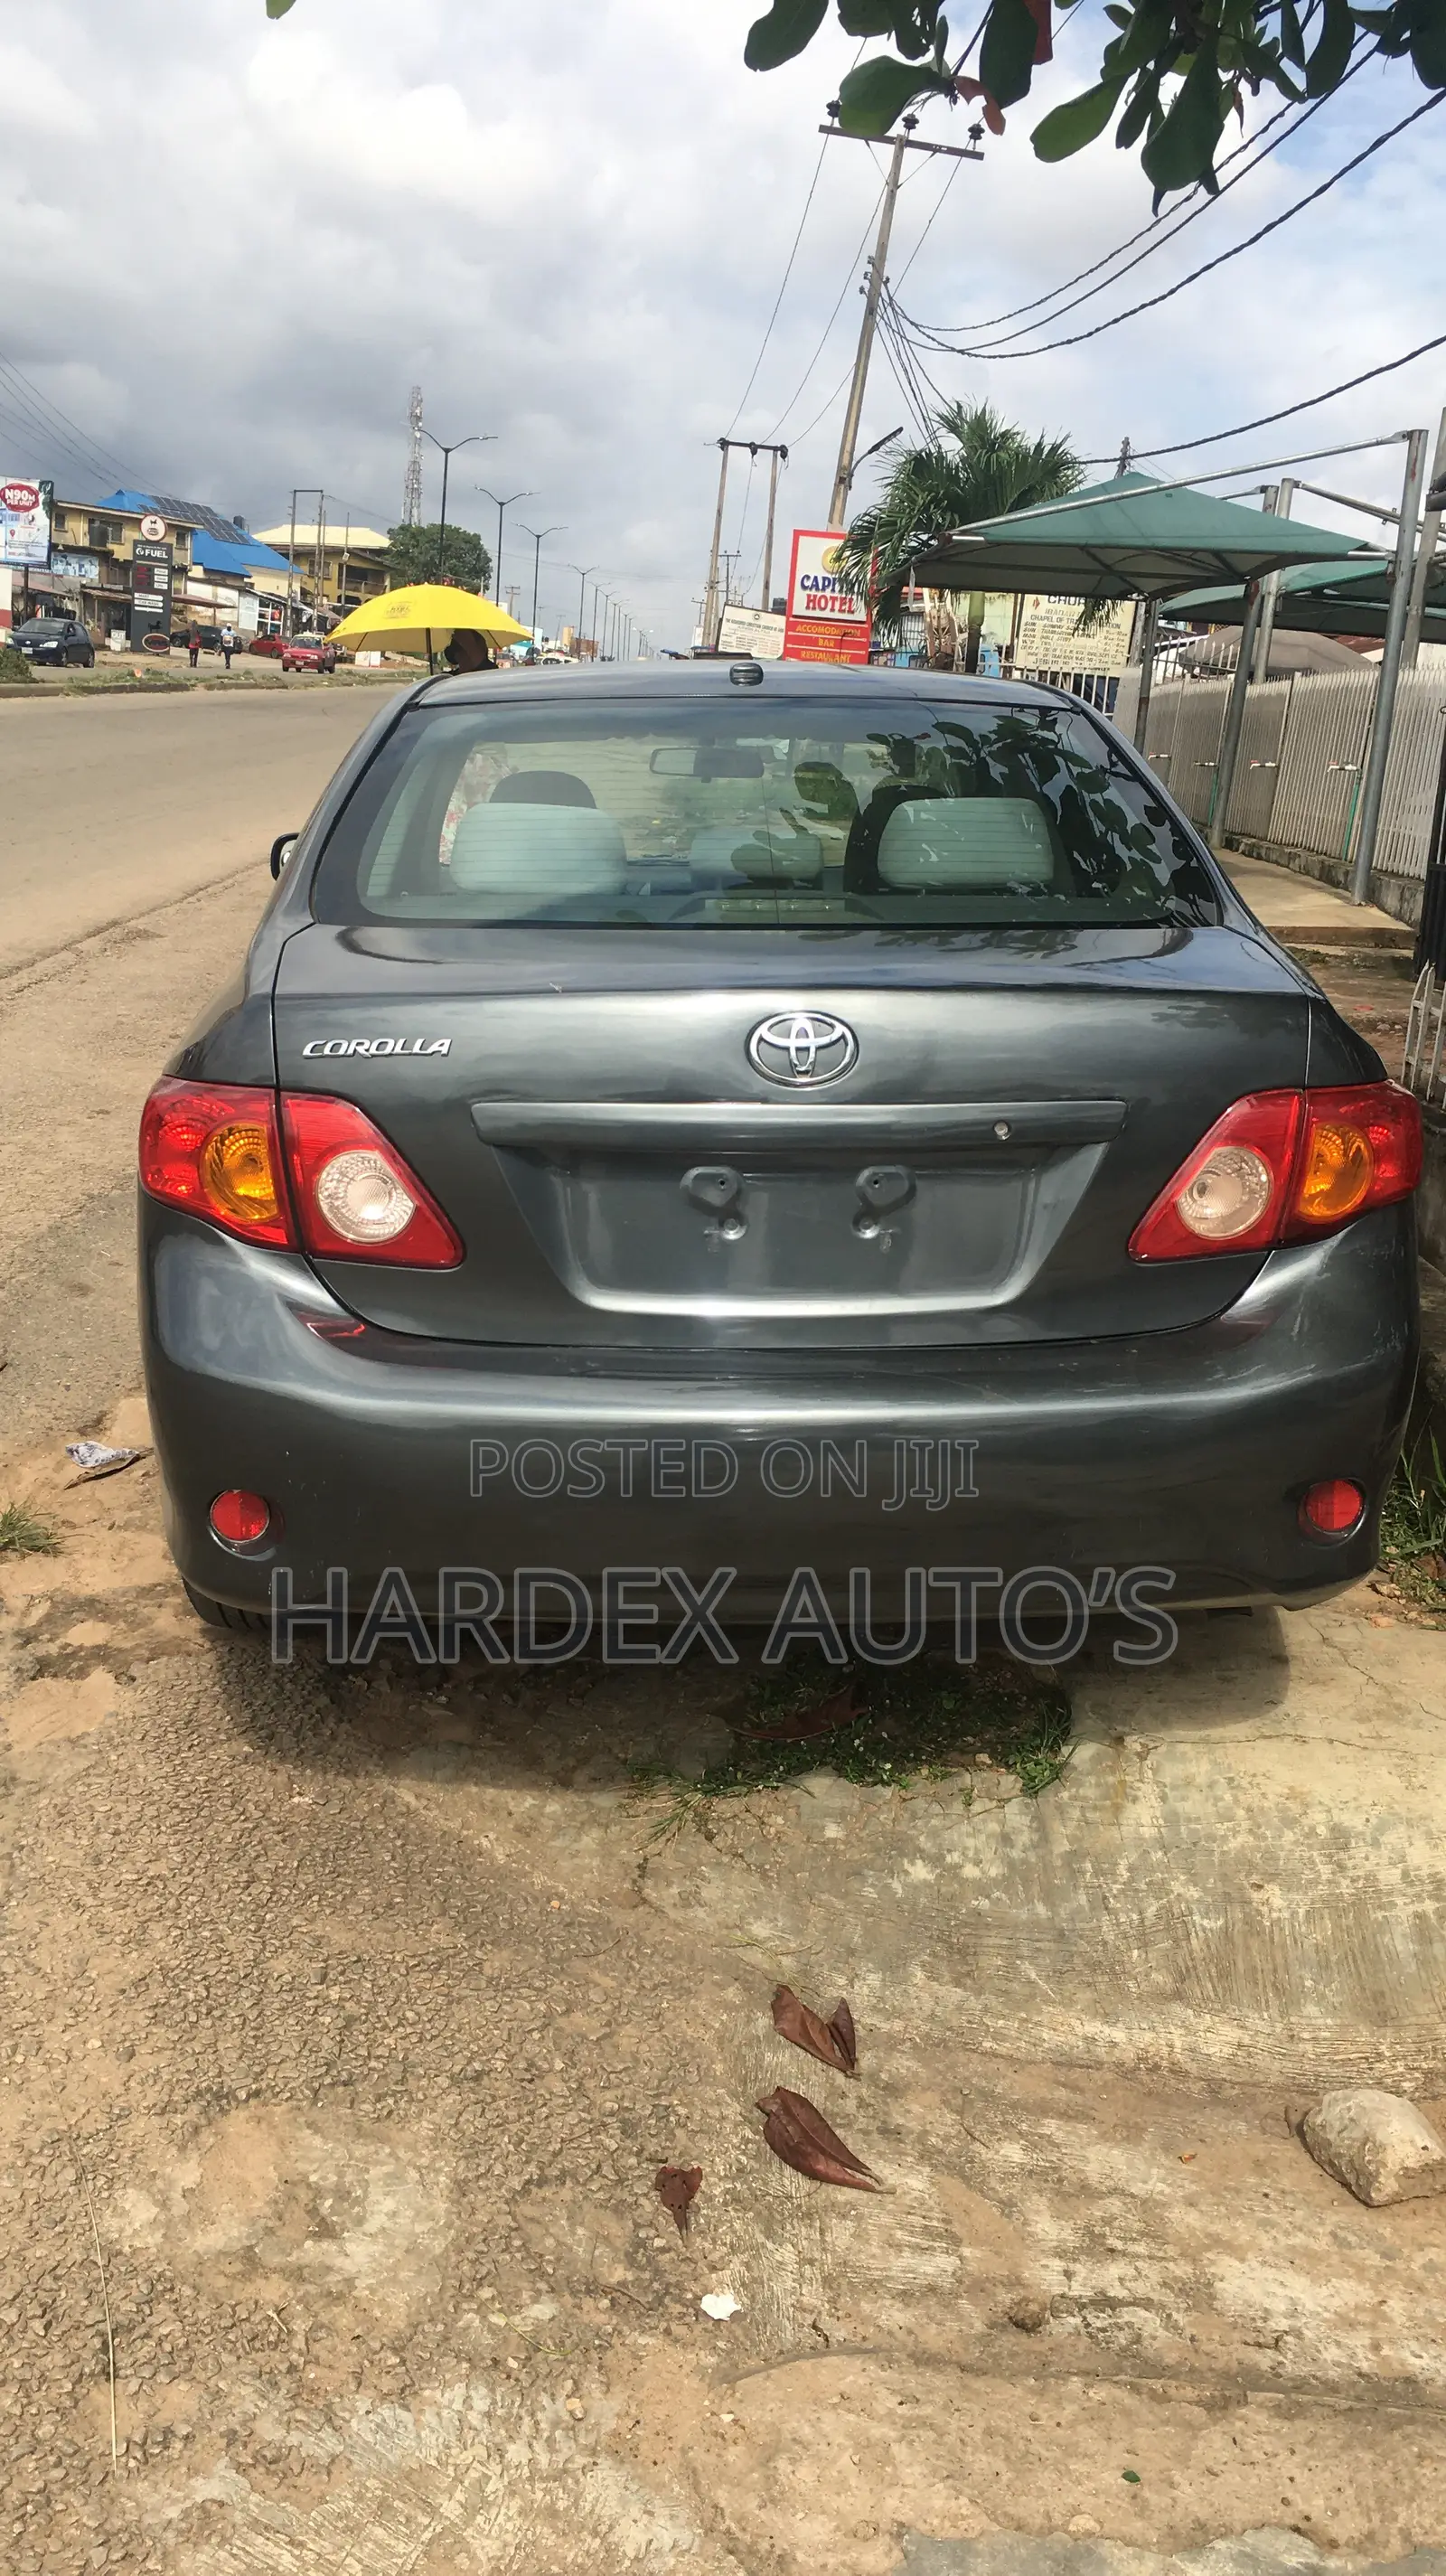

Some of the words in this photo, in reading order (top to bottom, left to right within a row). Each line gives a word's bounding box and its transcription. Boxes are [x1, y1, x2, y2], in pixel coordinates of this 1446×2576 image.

[145, 549, 168, 559] FUEL
[805, 593, 856, 615] HOTEL
[1030, 615, 1054, 623] CHAPEL
[818, 637, 835, 647] BAR
[302, 1038, 452, 1058] COROLLA
